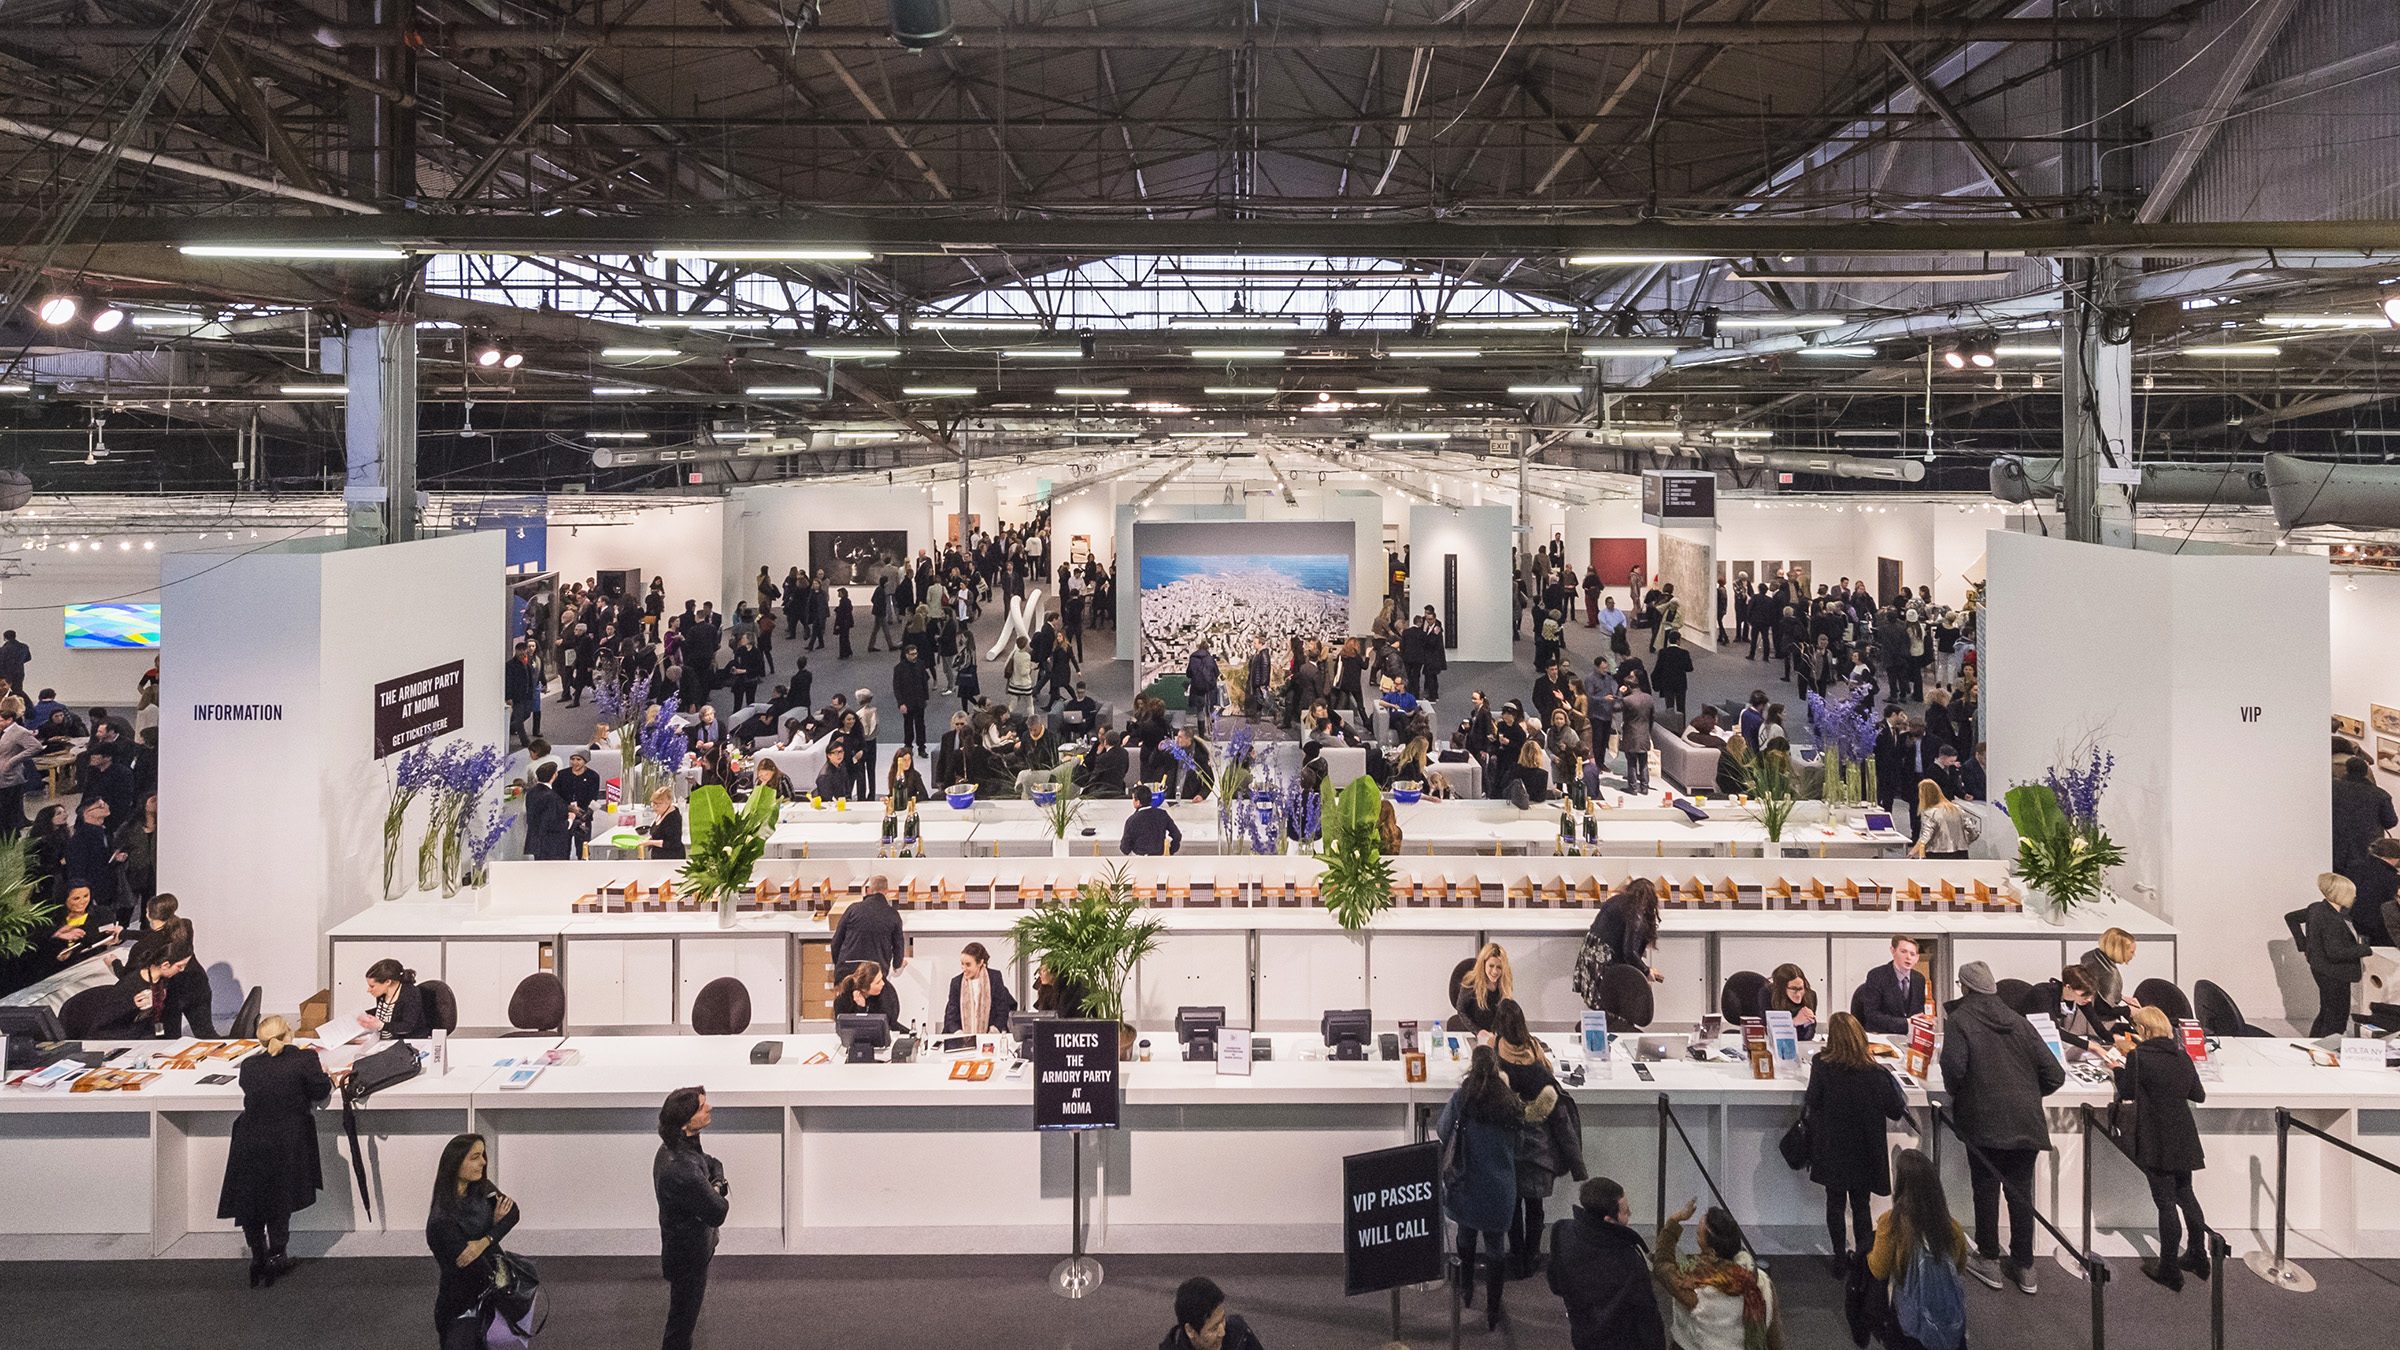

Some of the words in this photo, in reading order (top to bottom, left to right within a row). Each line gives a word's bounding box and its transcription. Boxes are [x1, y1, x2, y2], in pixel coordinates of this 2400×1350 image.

[1491, 442, 1510, 450] EXIT
[380, 689, 397, 707] THE
[398, 678, 434, 702] ARMORY
[434, 670, 460, 691] PARTY
[194, 704, 282, 721] INFORMATION
[402, 702, 413, 719] AT
[414, 694, 440, 715] MOMA
[2240, 706, 2262, 723] VIP
[392, 732, 405, 747] GET
[406, 723, 432, 742] TICKETS
[1054, 1033, 1099, 1048] TICKETS
[1066, 1054, 1084, 1067] THE
[1042, 1070, 1081, 1083] ARMORY
[1083, 1070, 1112, 1083] PARTY
[1071, 1087, 1082, 1099] AT
[1062, 1102, 1092, 1115] MOMA
[1353, 1191, 1376, 1213] VIP
[1381, 1181, 1433, 1208] PASSES
[1358, 1225, 1392, 1248] WILL
[1395, 1218, 1430, 1241] CALL
